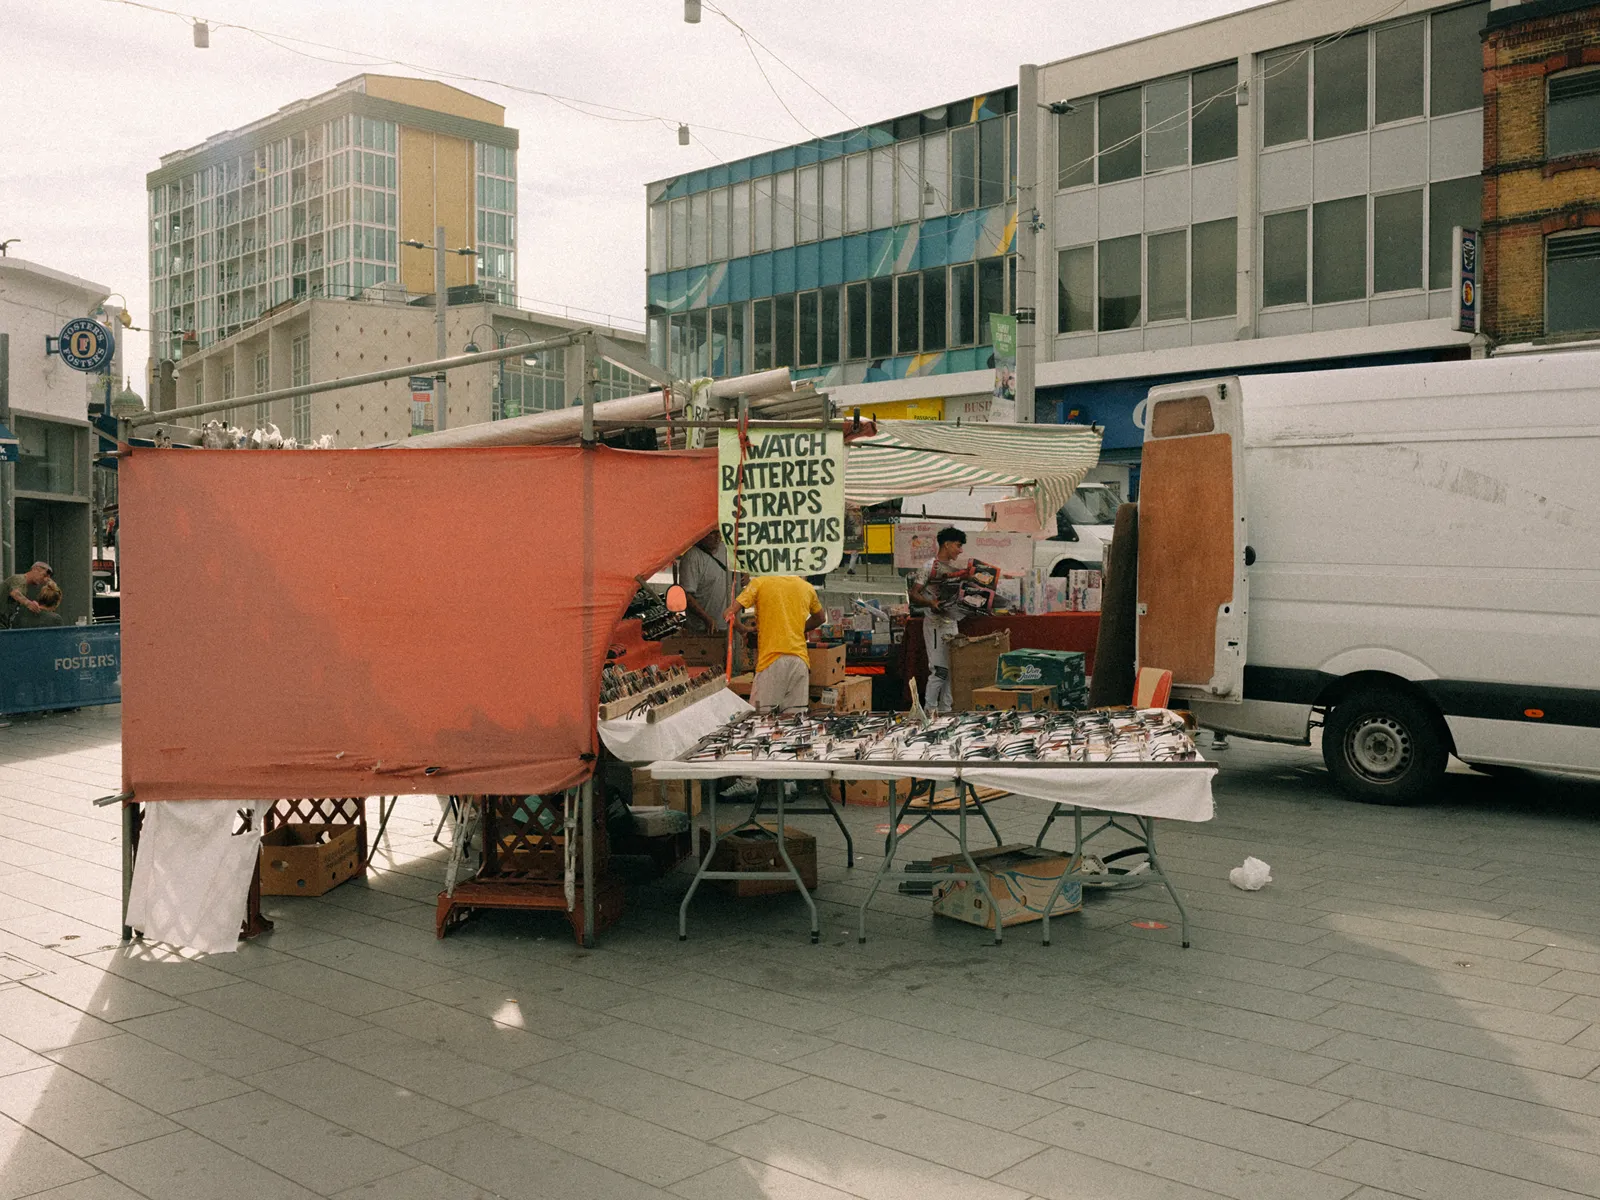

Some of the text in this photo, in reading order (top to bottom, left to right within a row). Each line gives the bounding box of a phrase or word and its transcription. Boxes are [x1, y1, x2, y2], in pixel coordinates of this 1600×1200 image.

[63, 321, 104, 341] FOSTER'S
[745, 433, 826, 460] WATCH
[722, 458, 835, 491] BATTERIES
[732, 489, 823, 519] STRAPS
[734, 547, 791, 573] FROM
[55, 654, 115, 670] FOSTER'S
[1026, 665, 1040, 674] Don
